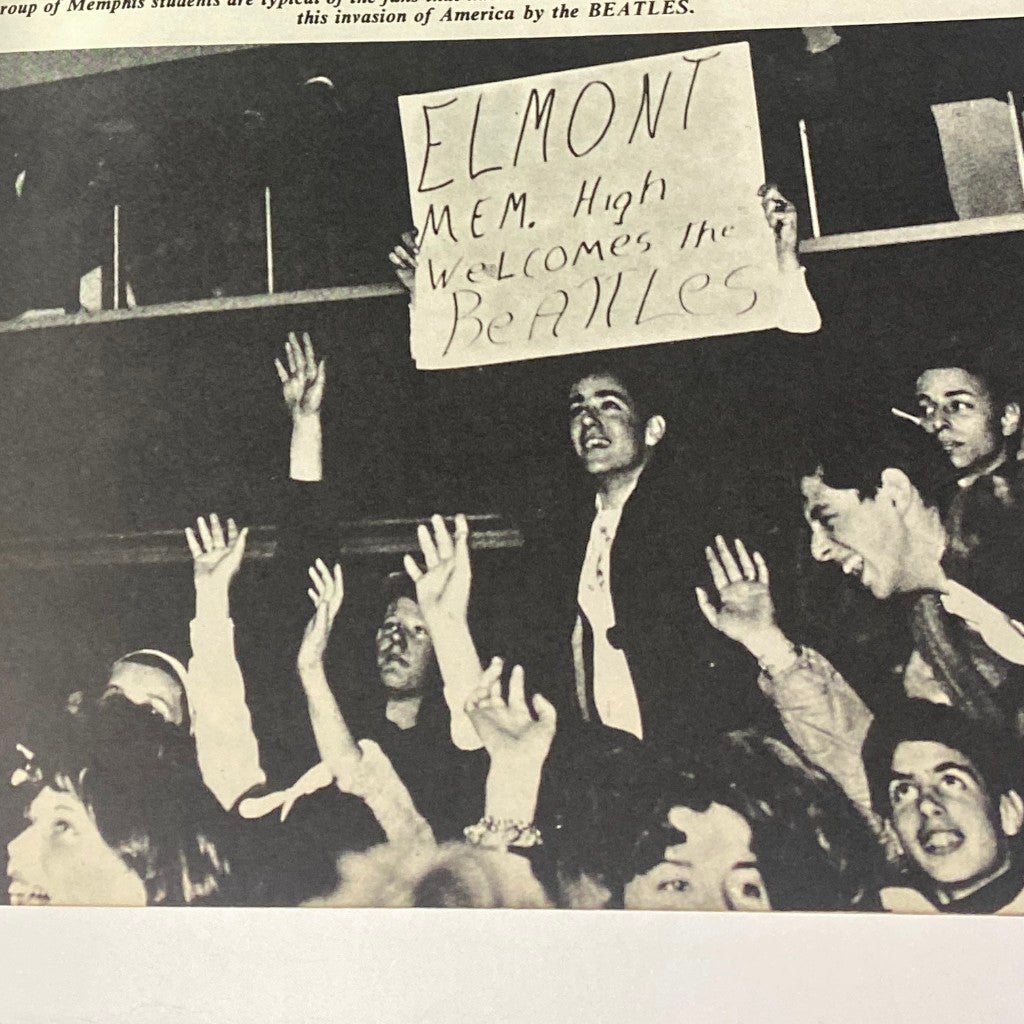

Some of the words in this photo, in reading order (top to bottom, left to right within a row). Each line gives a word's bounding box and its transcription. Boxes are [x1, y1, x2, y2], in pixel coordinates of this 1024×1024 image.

[297, 10, 328, 25] this
[335, 8, 407, 24] invasion
[414, 7, 435, 26] of
[439, 6, 515, 22] America
[523, 5, 544, 23] by
[552, 3, 579, 19] the
[588, 0, 695, 17] BEATLES.
[418, 51, 721, 193] ELMONT
[415, 193, 536, 247] MEM.
[573, 170, 666, 225] High
